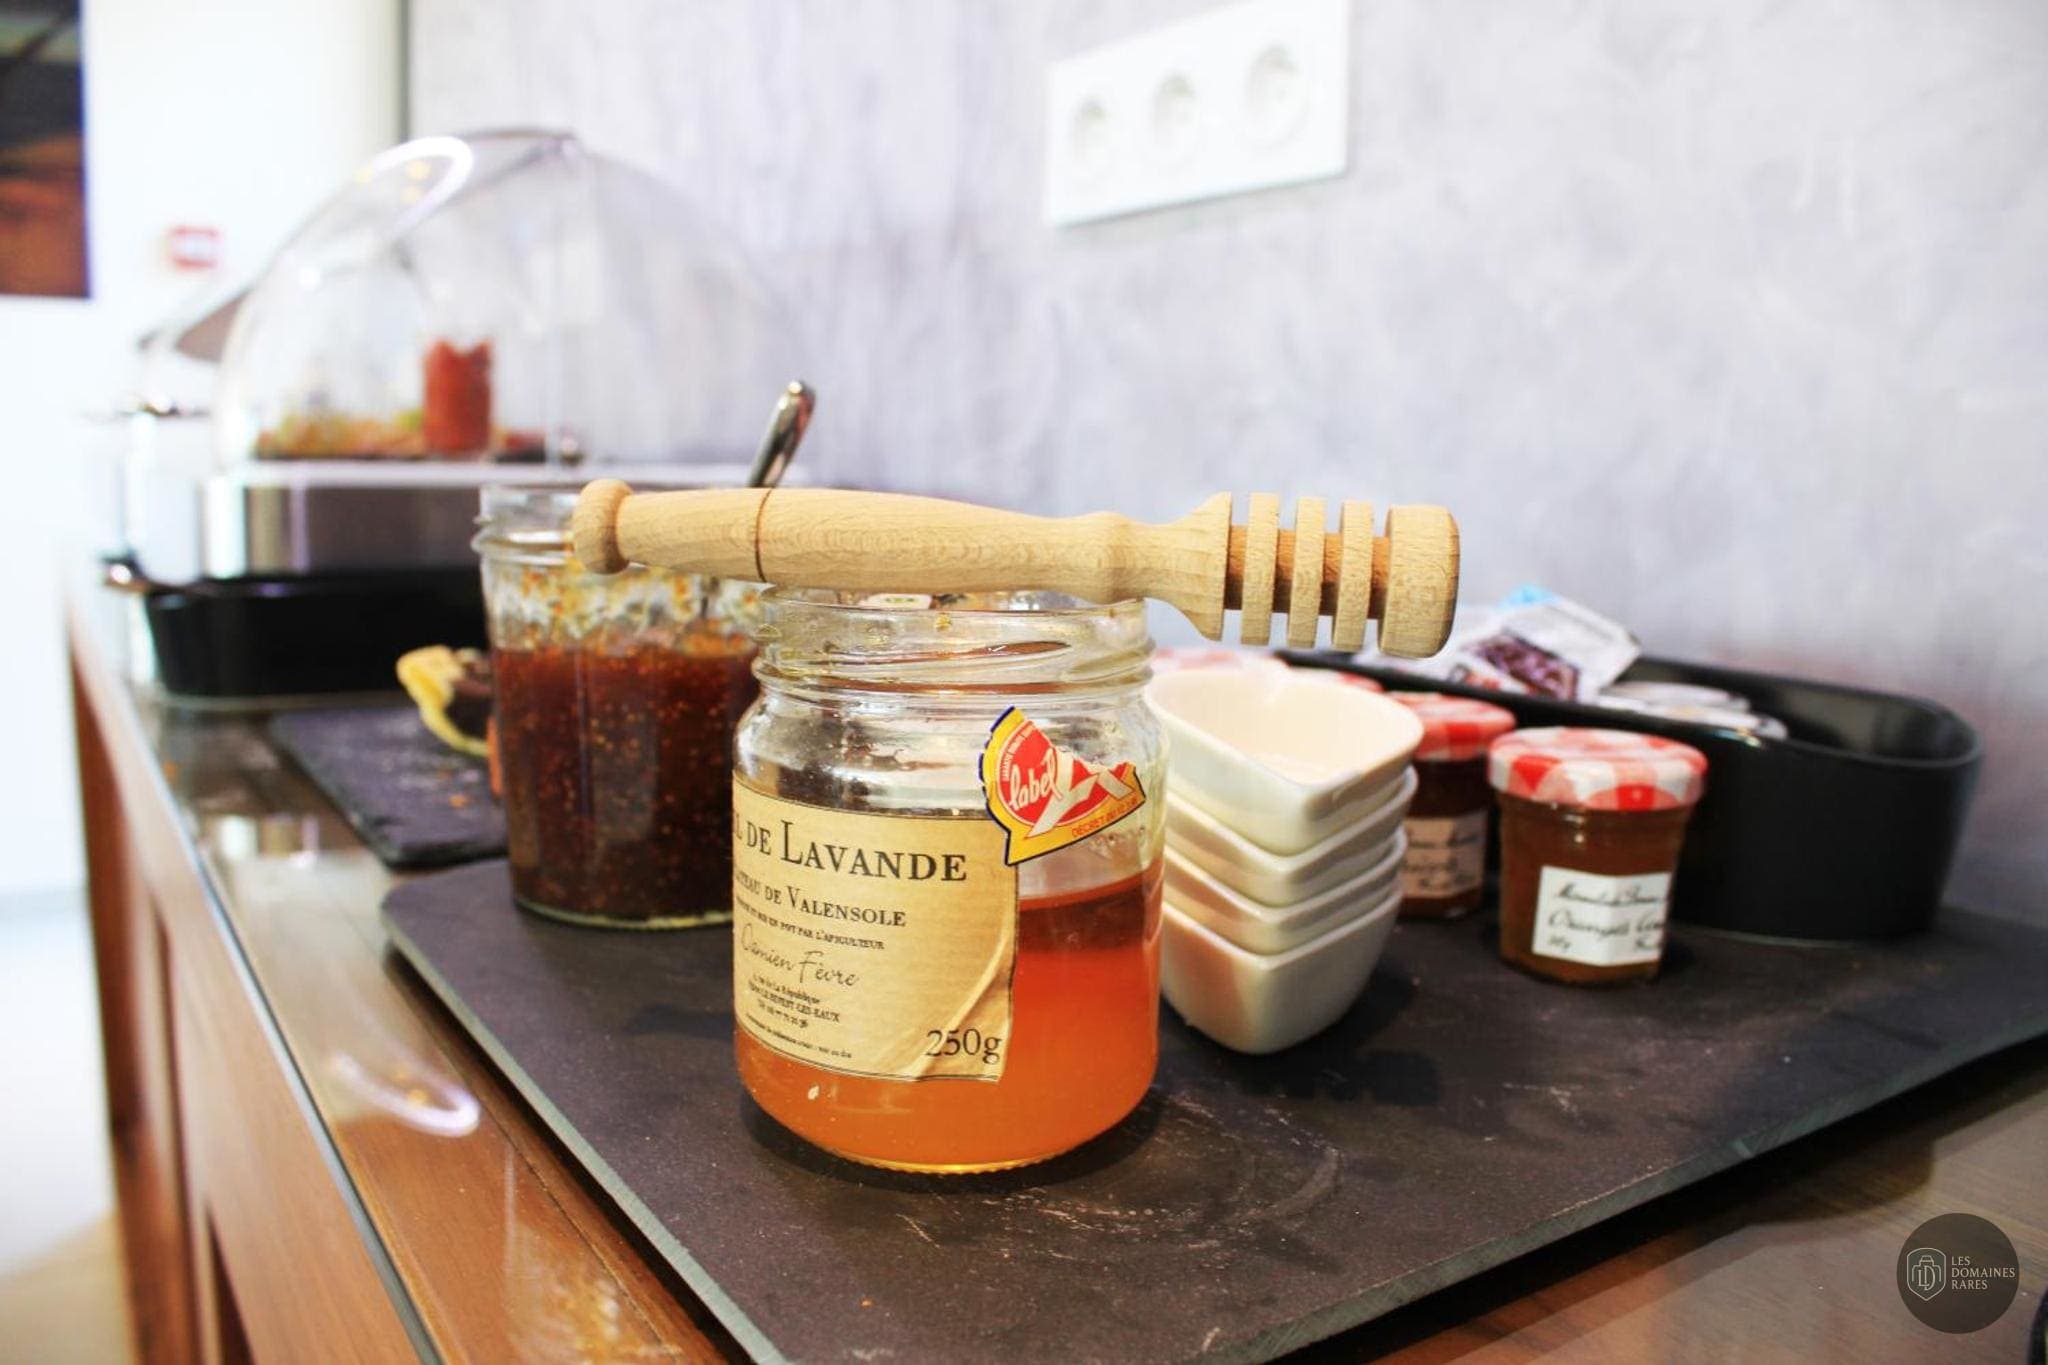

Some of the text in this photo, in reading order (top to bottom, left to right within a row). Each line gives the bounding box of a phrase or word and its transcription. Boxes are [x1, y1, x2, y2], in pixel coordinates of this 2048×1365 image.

[1009, 746, 1064, 811] label
[747, 821, 772, 855] DE
[781, 819, 967, 882] LAVANDE
[765, 886, 782, 905] DE
[786, 885, 907, 927] VALENSOLE
[925, 1028, 1003, 1066] 250g
